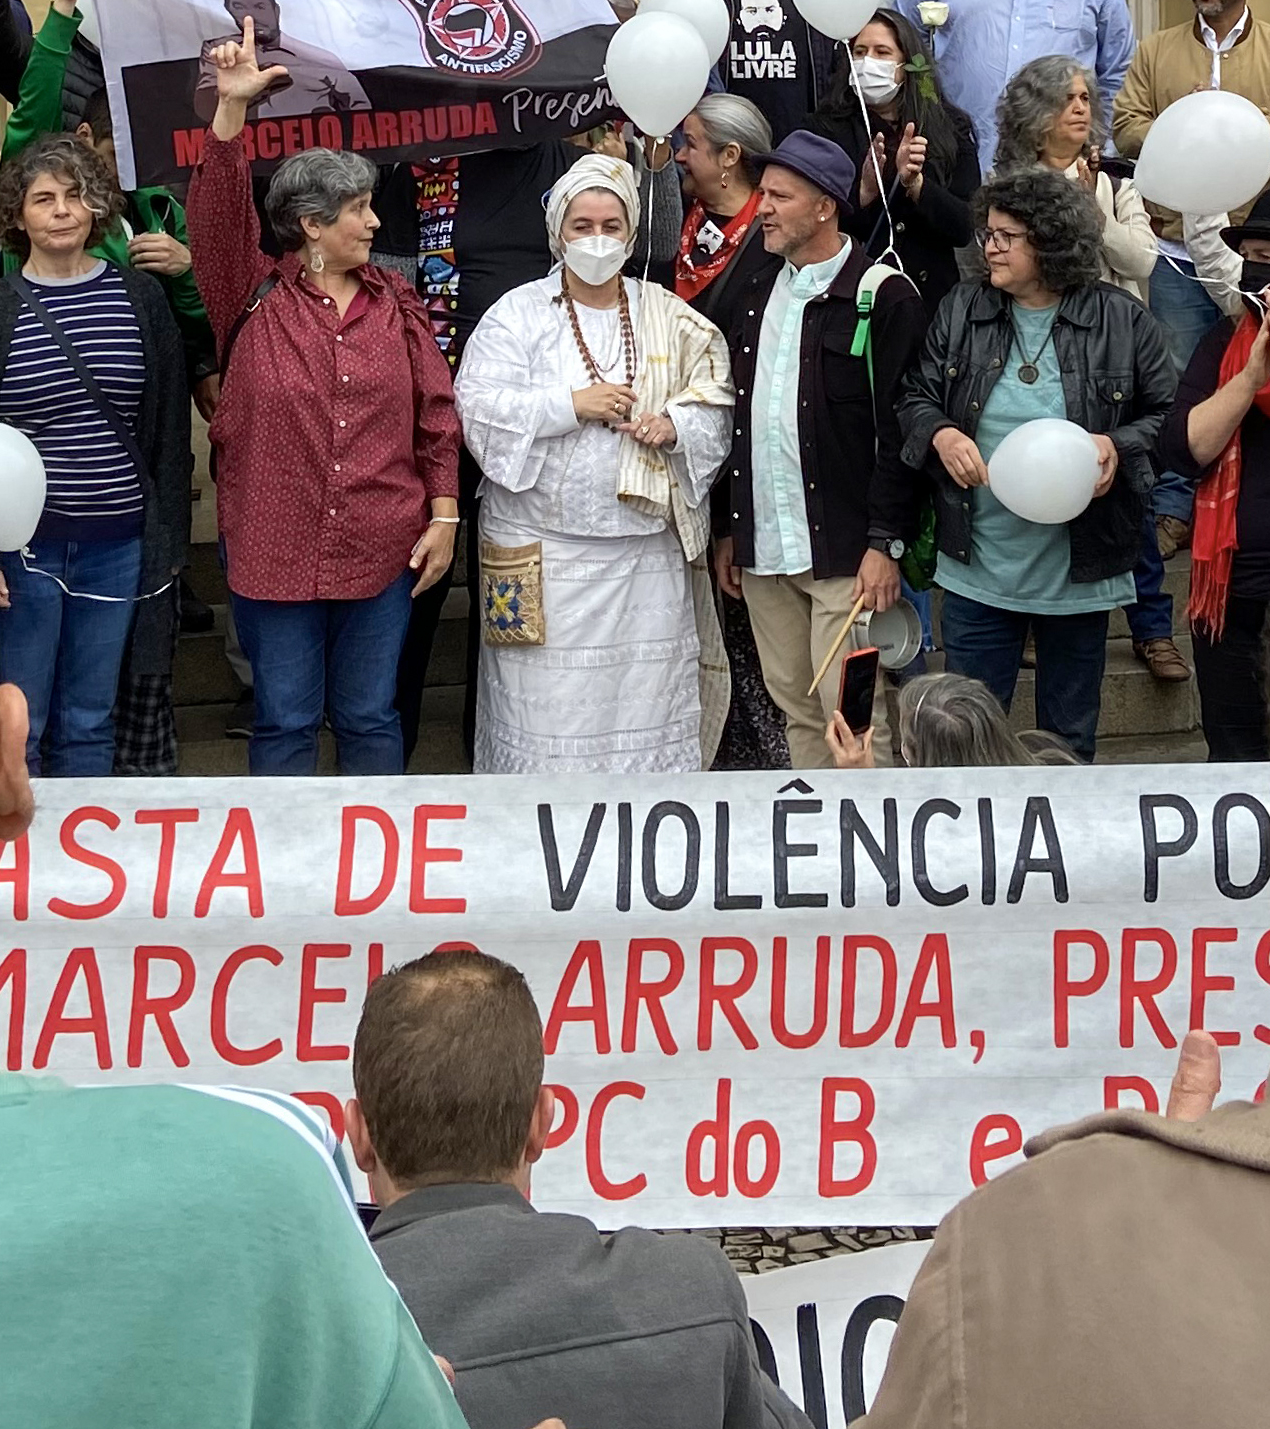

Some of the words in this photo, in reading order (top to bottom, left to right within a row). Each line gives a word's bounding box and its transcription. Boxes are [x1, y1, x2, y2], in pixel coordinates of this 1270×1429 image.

[436, 30, 528, 74] ANTIFASCISMO
[731, 40, 796, 60] LULA
[731, 60, 796, 79] LIVRE
[173, 115, 343, 167] MRCELO
[352, 102, 498, 150] ARRUDA
[502, 86, 620, 133] Presen
[334, 803, 468, 917] DE
[537, 777, 1068, 912] VIOLÊNCIA
[544, 931, 987, 1064] ARRUDA,
[685, 1077, 781, 1198] do
[817, 1076, 878, 1198] B
[969, 1113, 1023, 1188] e
